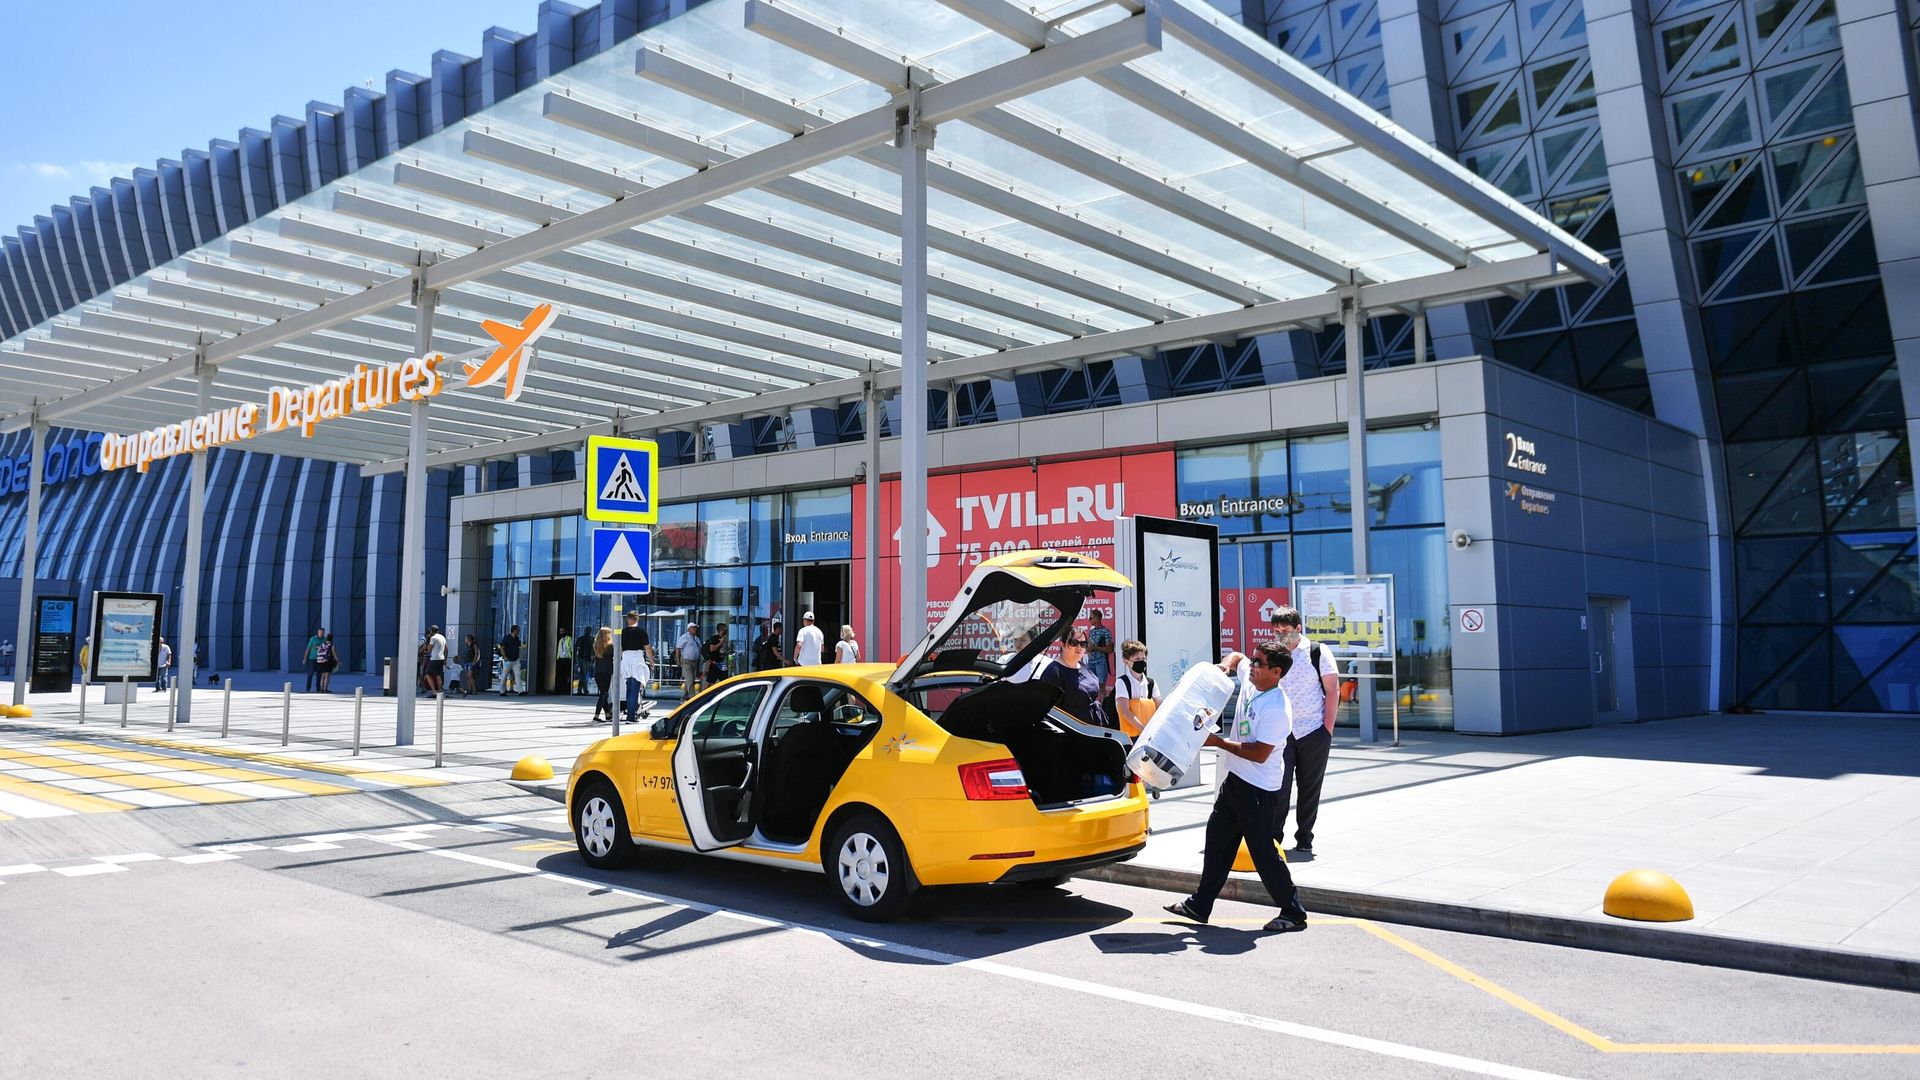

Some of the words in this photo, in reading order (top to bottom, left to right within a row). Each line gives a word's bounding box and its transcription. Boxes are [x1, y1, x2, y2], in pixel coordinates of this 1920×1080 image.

[100, 403, 258, 473] Отправление
[266, 353, 442, 438] Departures
[1507, 432, 1518, 468] 2
[1517, 436, 1536, 456] Вход
[1518, 455, 1547, 475] Entrance
[956, 482, 1125, 531] TVIL.RU
[1180, 503, 1215, 517] Вход
[1221, 498, 1284, 514] Entrance
[785, 533, 807, 544] Вход
[811, 530, 849, 542] Entrance
[956, 541, 983, 566] 75
[1154, 601, 1165, 615] 55
[648, 775, 658, 789] +7
